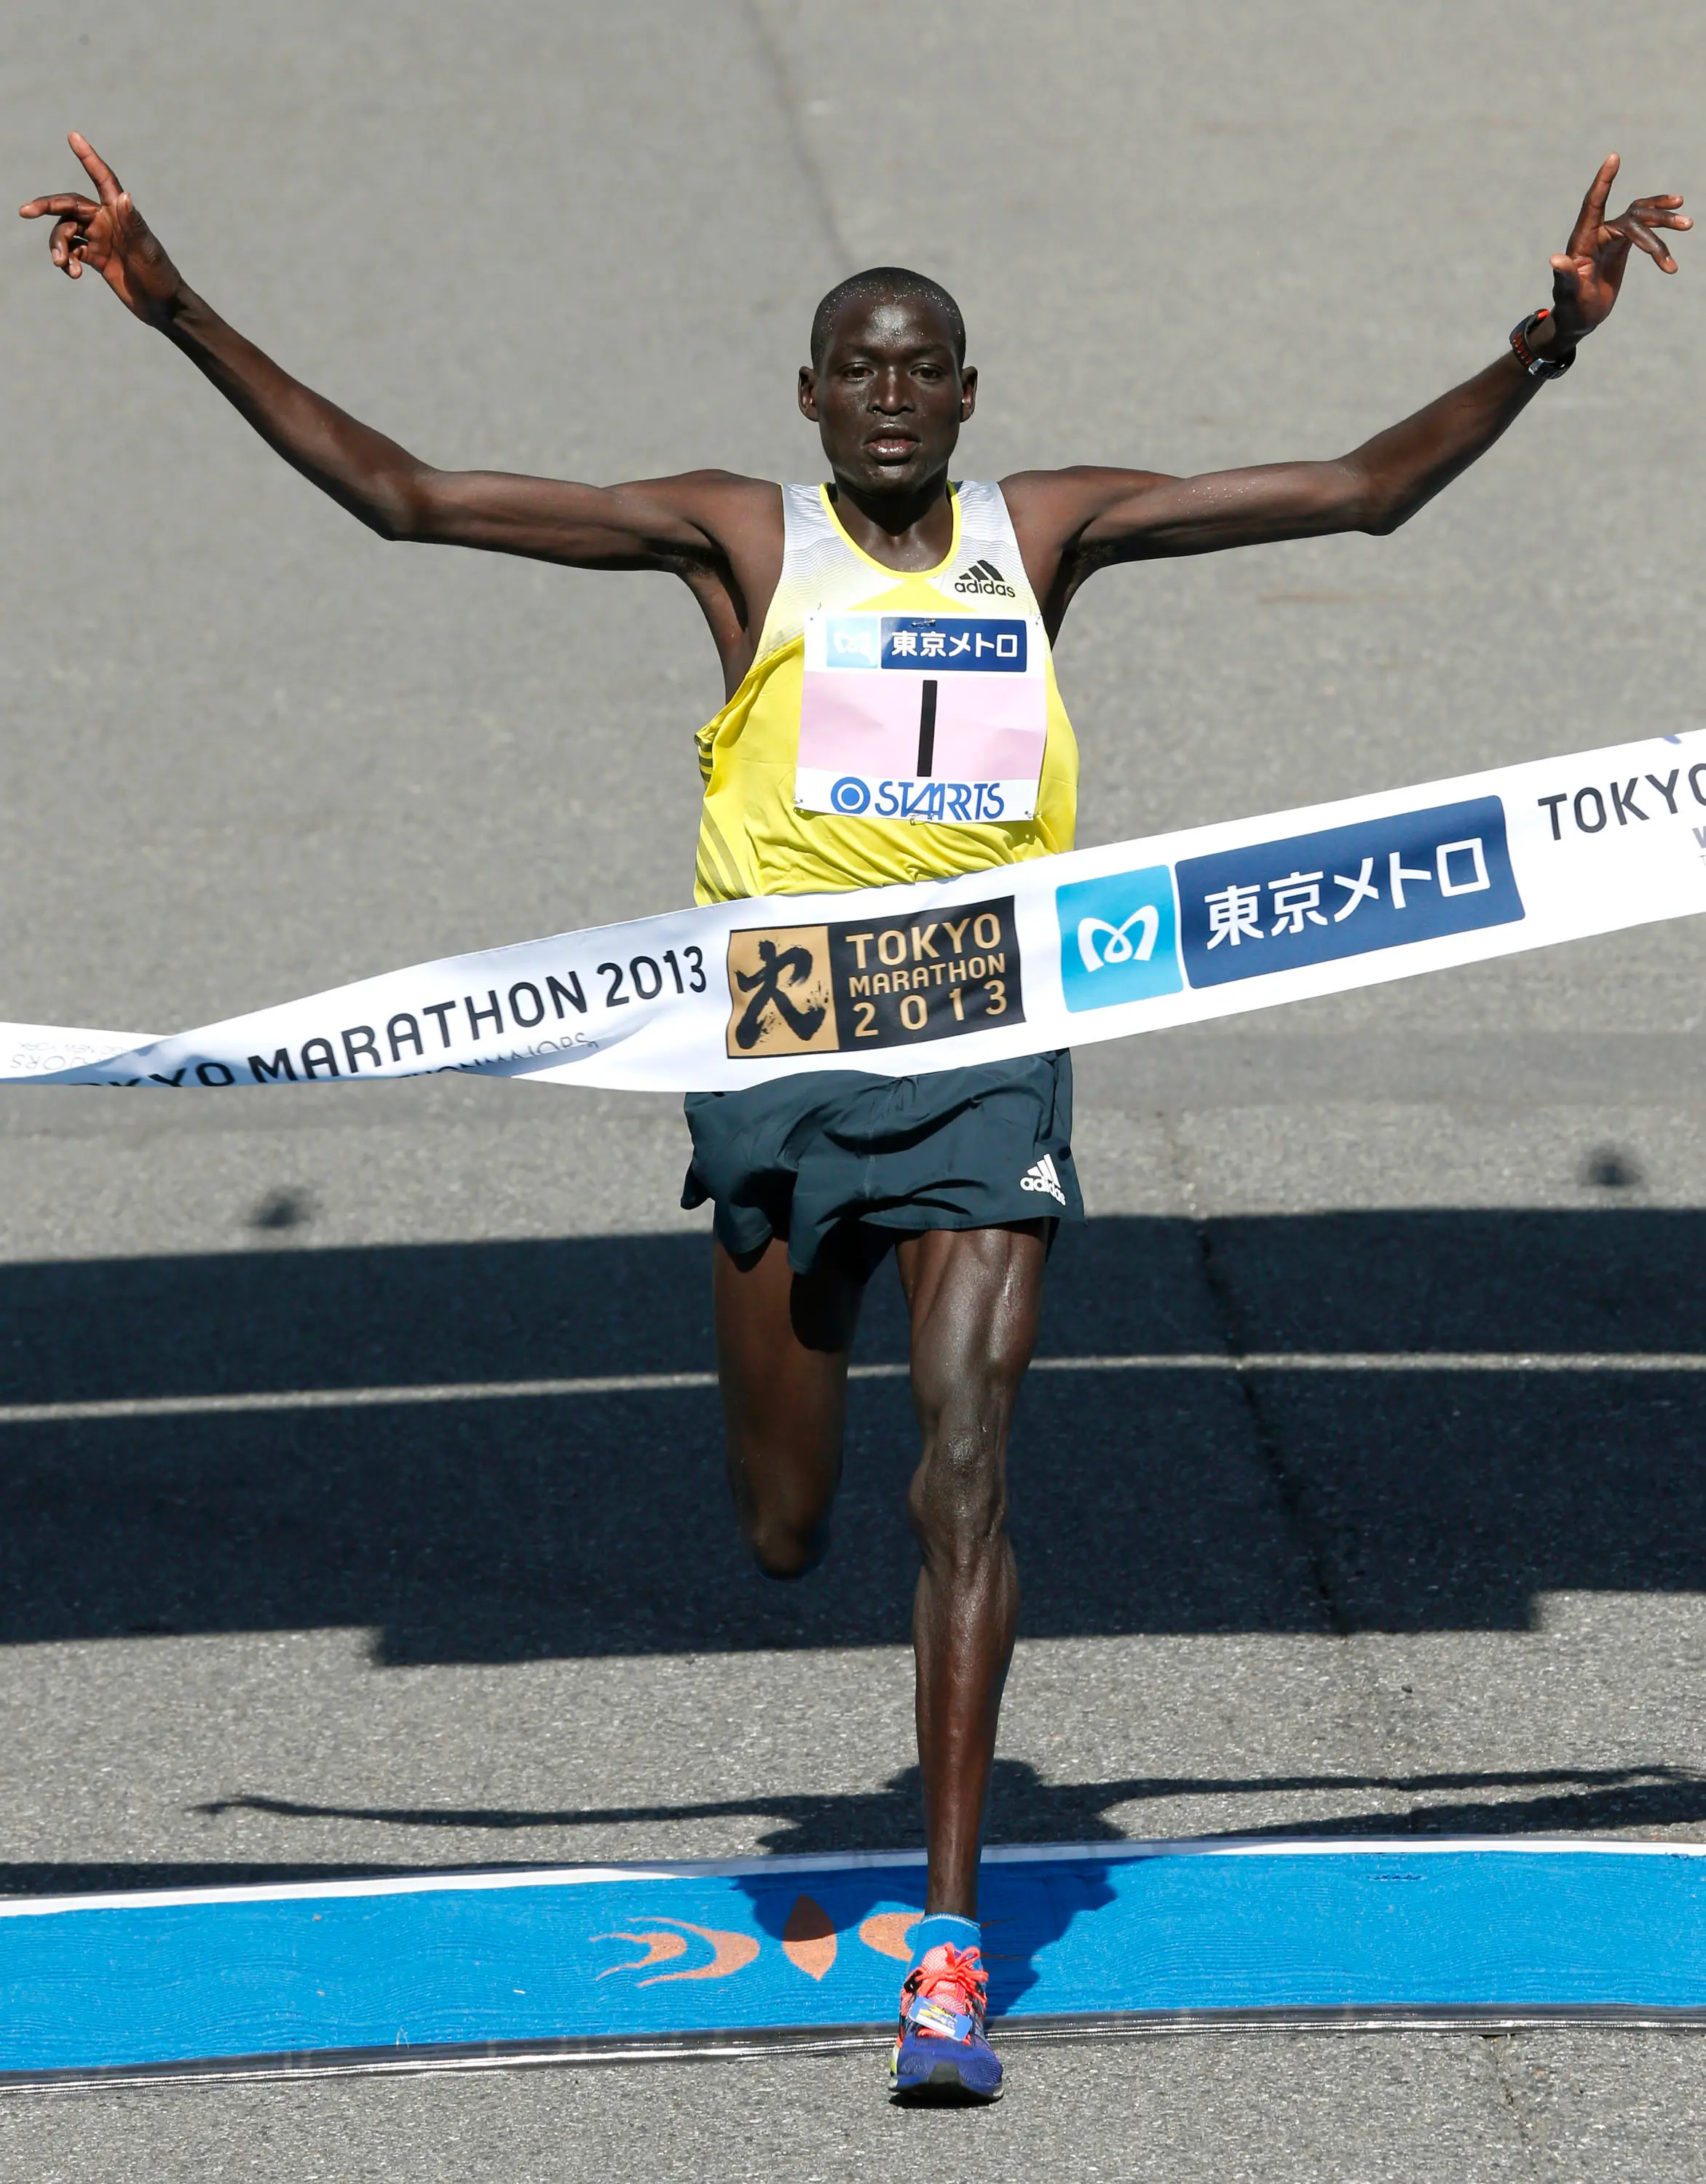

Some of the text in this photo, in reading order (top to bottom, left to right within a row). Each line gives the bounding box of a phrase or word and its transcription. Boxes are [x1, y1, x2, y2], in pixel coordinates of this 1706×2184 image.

[955, 580, 1016, 598] adidas
[891, 630, 1018, 658] 東京メトロ
[917, 679, 938, 778] 1
[1204, 838, 1490, 950] 東京メトロ
[845, 914, 1002, 969] TOKYO
[849, 952, 1006, 997] MARATHON
[248, 971, 588, 1083] MARATHON
[596, 946, 706, 1008] 2013
